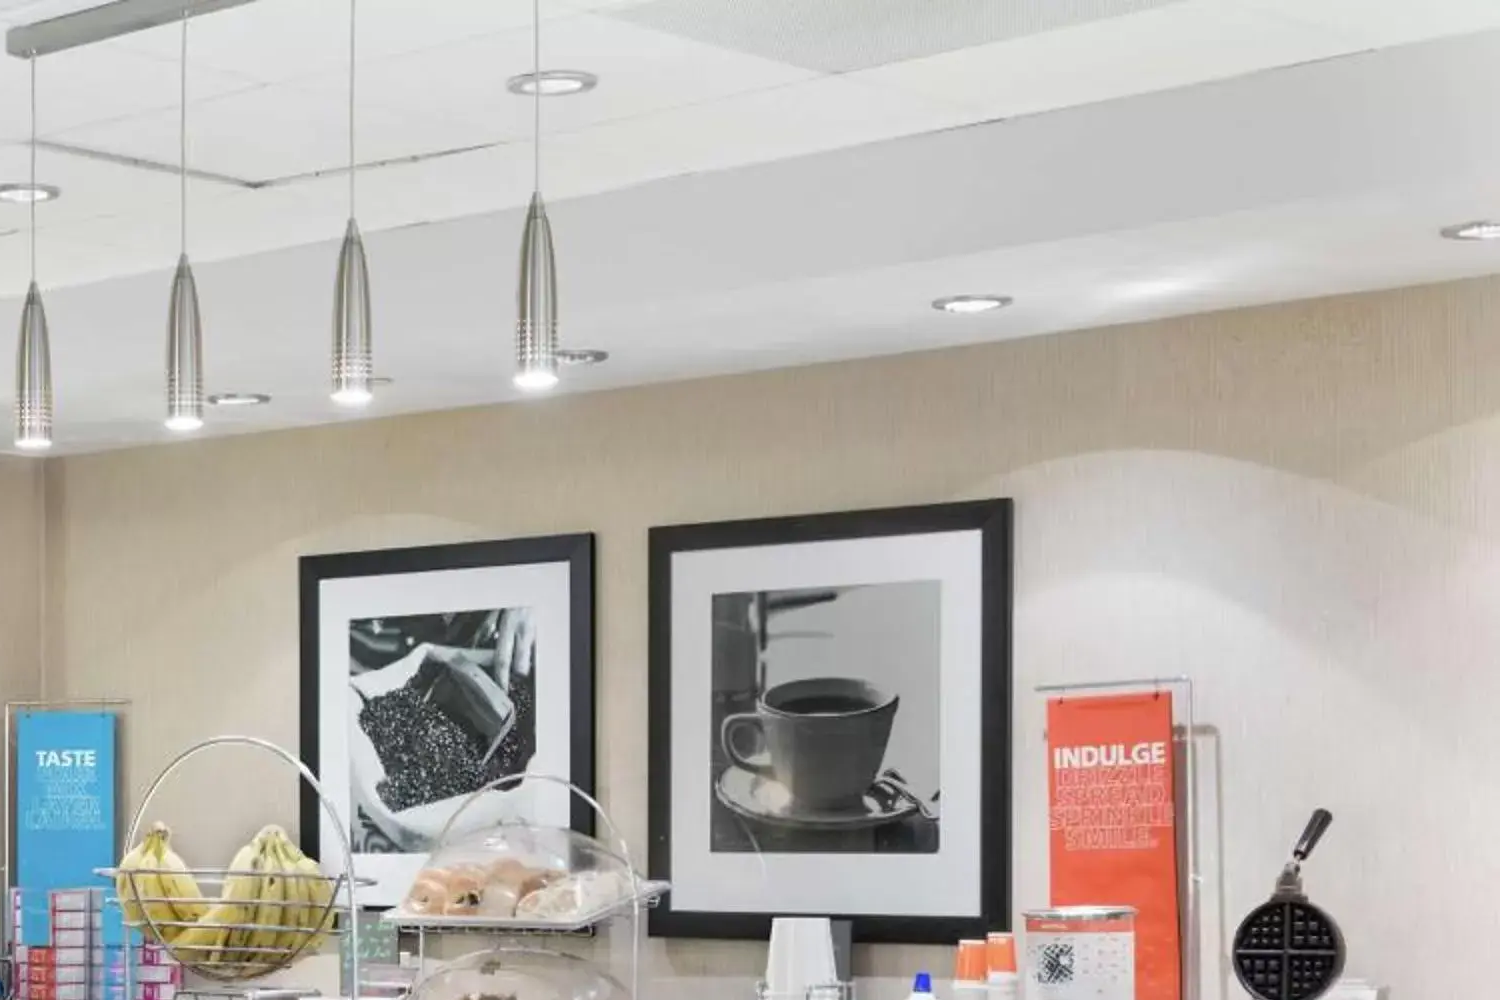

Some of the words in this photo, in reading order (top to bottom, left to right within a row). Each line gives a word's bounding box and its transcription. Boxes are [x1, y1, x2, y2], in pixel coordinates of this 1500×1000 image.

[36, 750, 96, 767] TASTE
[1053, 742, 1165, 769] INDULGE
[1056, 783, 1165, 806] SPREAD
[1063, 825, 1159, 850] SMILE.
